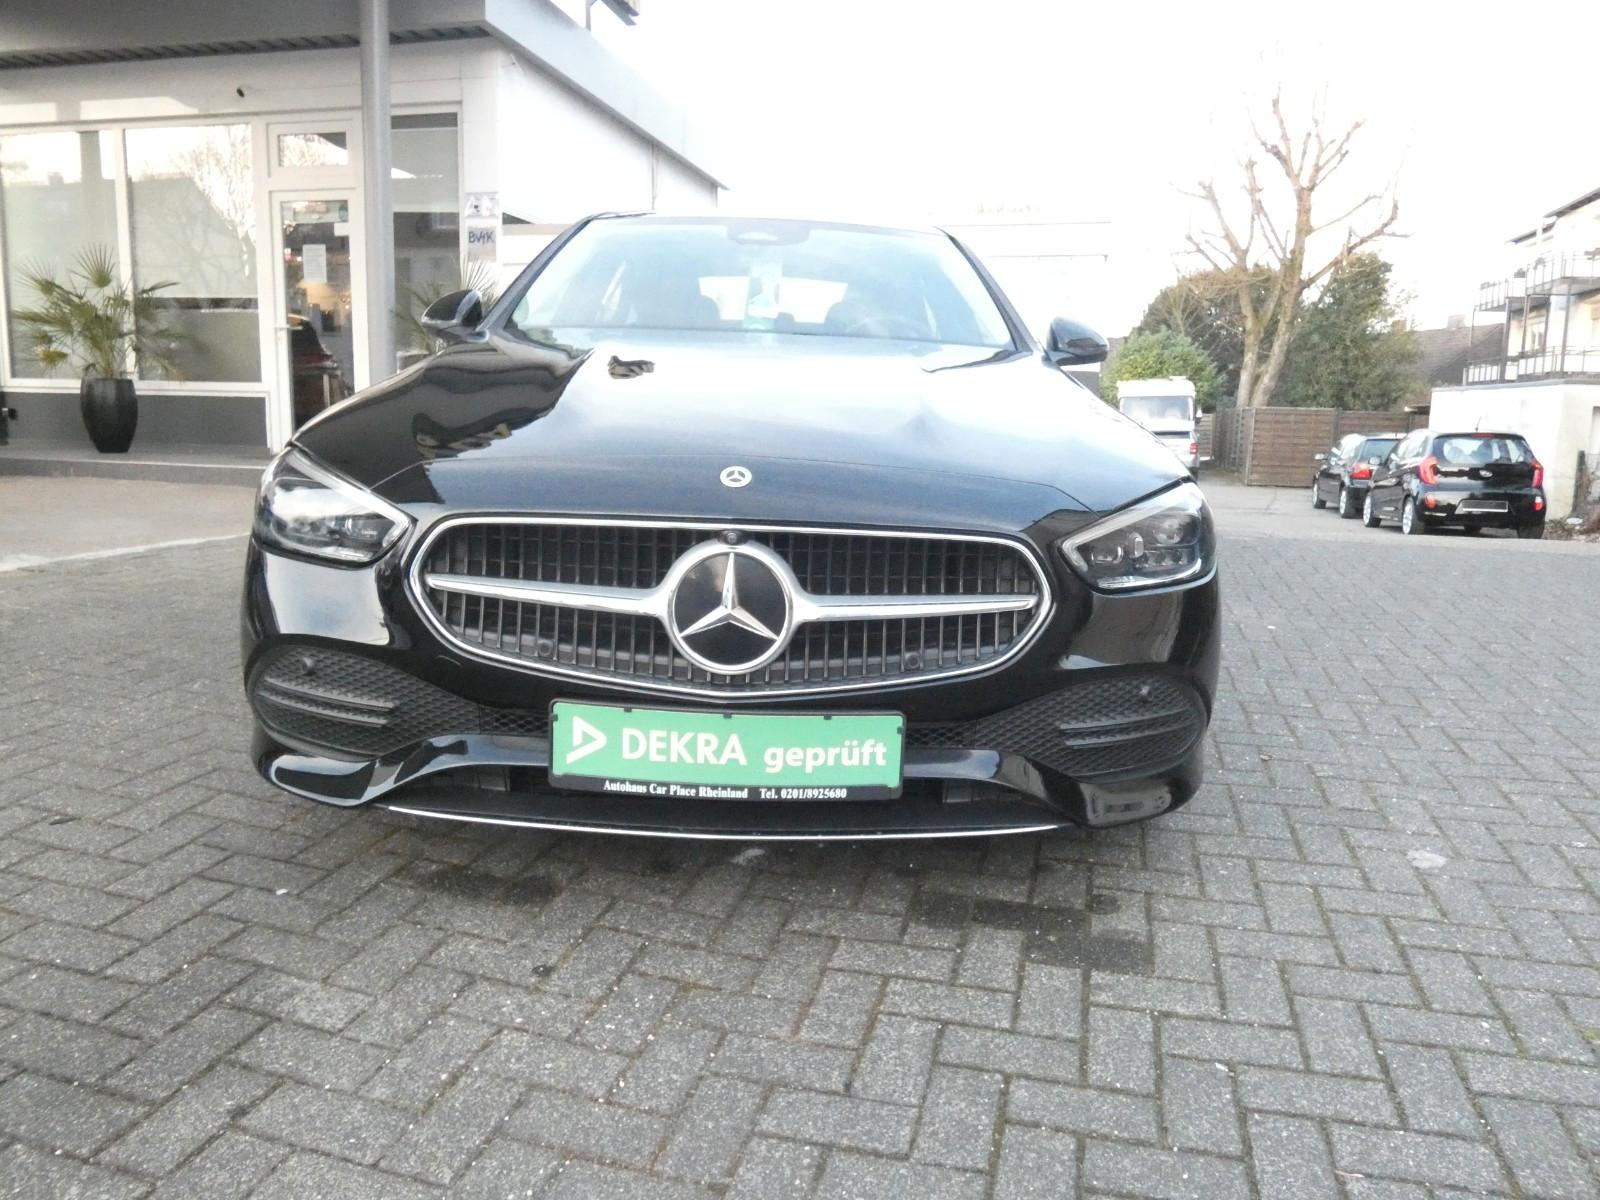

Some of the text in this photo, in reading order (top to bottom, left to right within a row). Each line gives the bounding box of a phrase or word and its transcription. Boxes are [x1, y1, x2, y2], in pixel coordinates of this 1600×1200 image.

[621, 728, 887, 774] DEKRA geprüft
[603, 780, 848, 799] Autohaus Car Place Rheinland Tel. 0201/8925680
